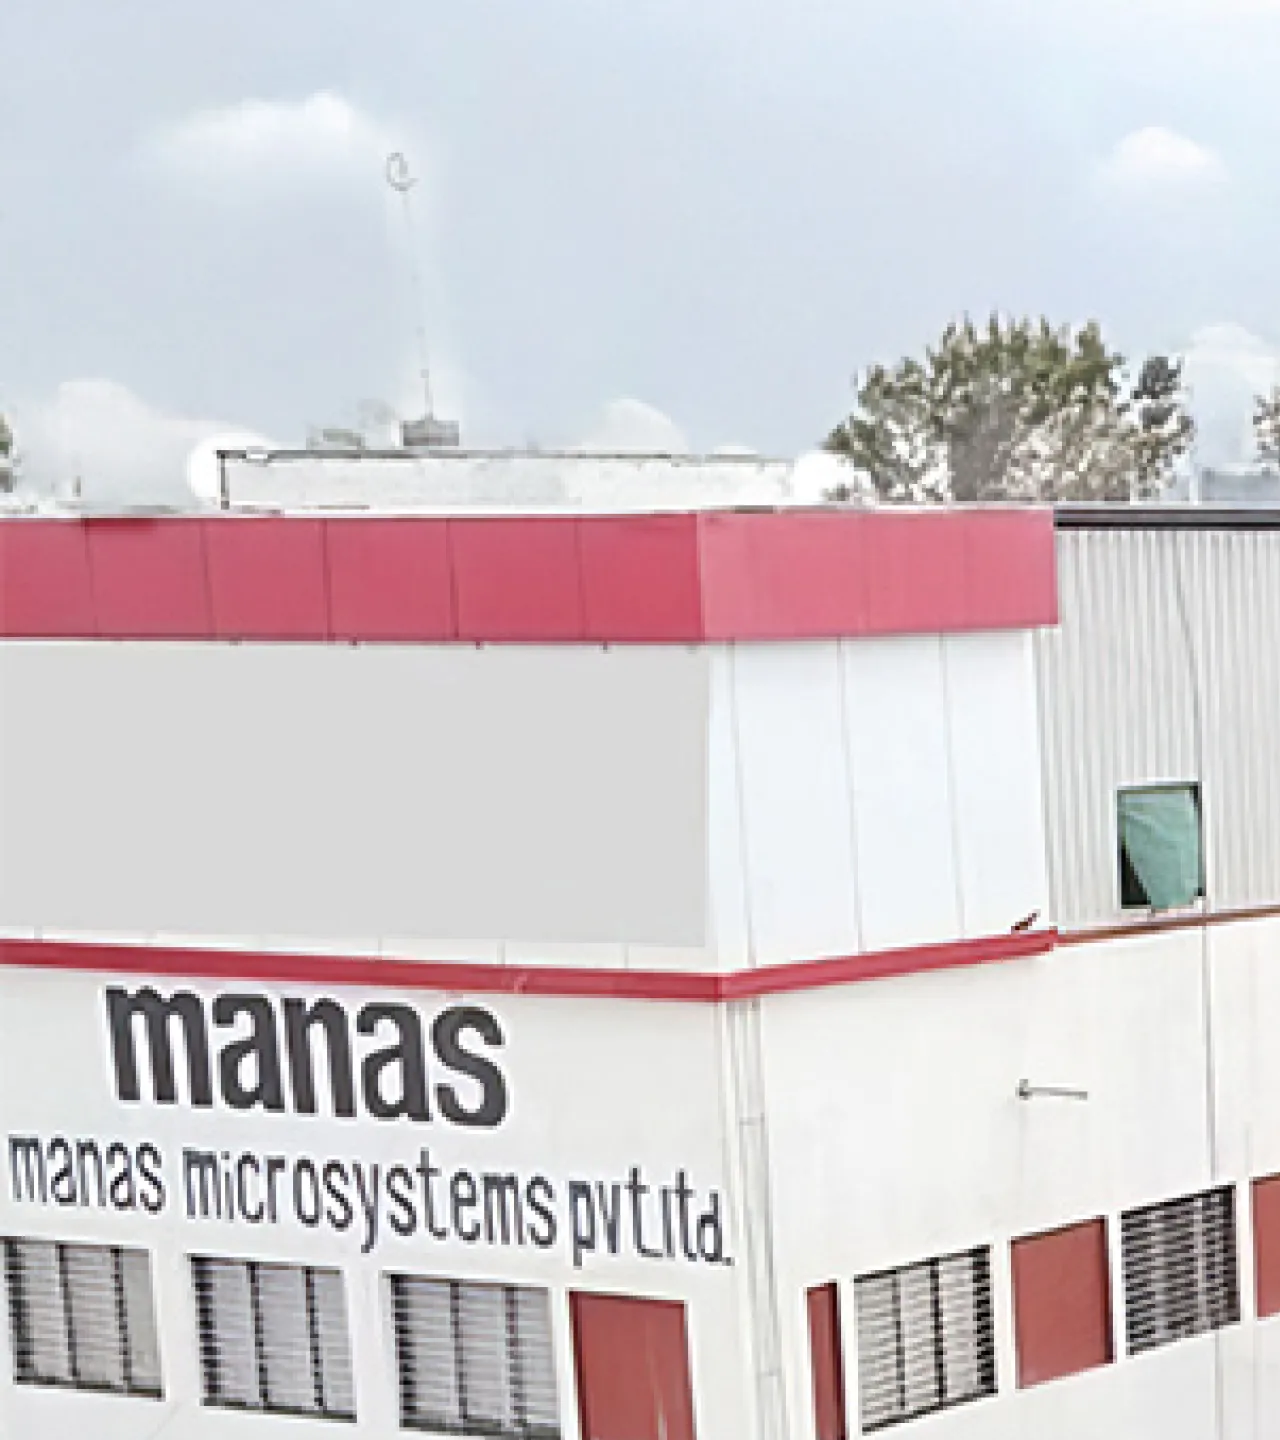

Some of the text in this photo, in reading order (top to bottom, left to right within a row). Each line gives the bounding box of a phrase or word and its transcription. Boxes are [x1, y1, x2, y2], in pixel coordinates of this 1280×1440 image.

[104, 985, 507, 1128] manas
[7, 1136, 166, 1214] manas
[181, 1147, 558, 1255] microsystems
